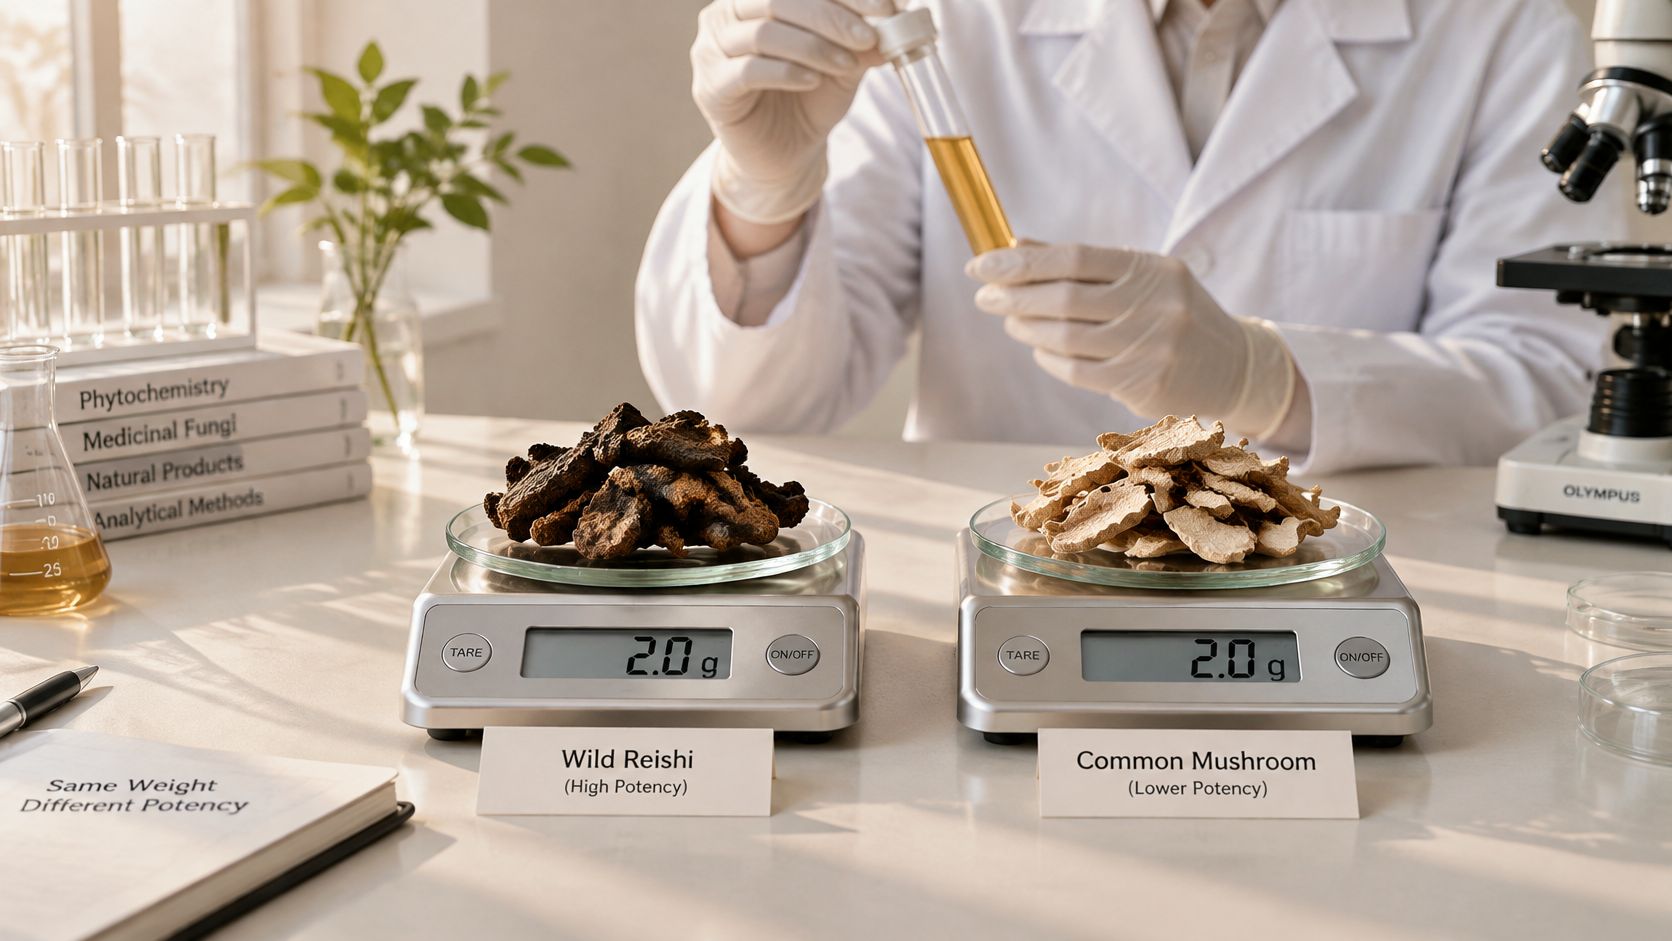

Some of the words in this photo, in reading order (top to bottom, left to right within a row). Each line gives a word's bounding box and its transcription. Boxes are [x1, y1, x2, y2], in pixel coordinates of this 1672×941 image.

[79, 378, 230, 412] Phytochemistry
[82, 420, 178, 452] Medicinal
[184, 413, 237, 440] Fungi
[86, 464, 156, 491] Natural
[162, 452, 244, 481] Products
[1563, 484, 1641, 504] OLYMPUS
[94, 499, 183, 530] Analytical
[187, 488, 264, 516] Methods
[449, 646, 483, 659] TARE
[626, 636, 692, 676] 2.0
[701, 654, 719, 679] g
[770, 648, 815, 661] ON/OFF
[1006, 650, 1040, 662] TARE
[1190, 638, 1256, 679] 2.0
[1267, 658, 1286, 682] g
[1339, 651, 1384, 664] ON/OFF
[561, 748, 615, 769] Wild
[624, 748, 694, 769] Reishi
[1076, 750, 1184, 771] Common
[1192, 750, 1317, 771] Mushroom
[46, 779, 118, 793] Same
[128, 778, 218, 796] Weight
[564, 778, 609, 796] (High
[614, 778, 688, 797] Potency)
[1128, 780, 1187, 798] (Lower
[1193, 780, 1268, 799] Potency)
[20, 798, 133, 813] Different
[141, 798, 249, 815] Potency
